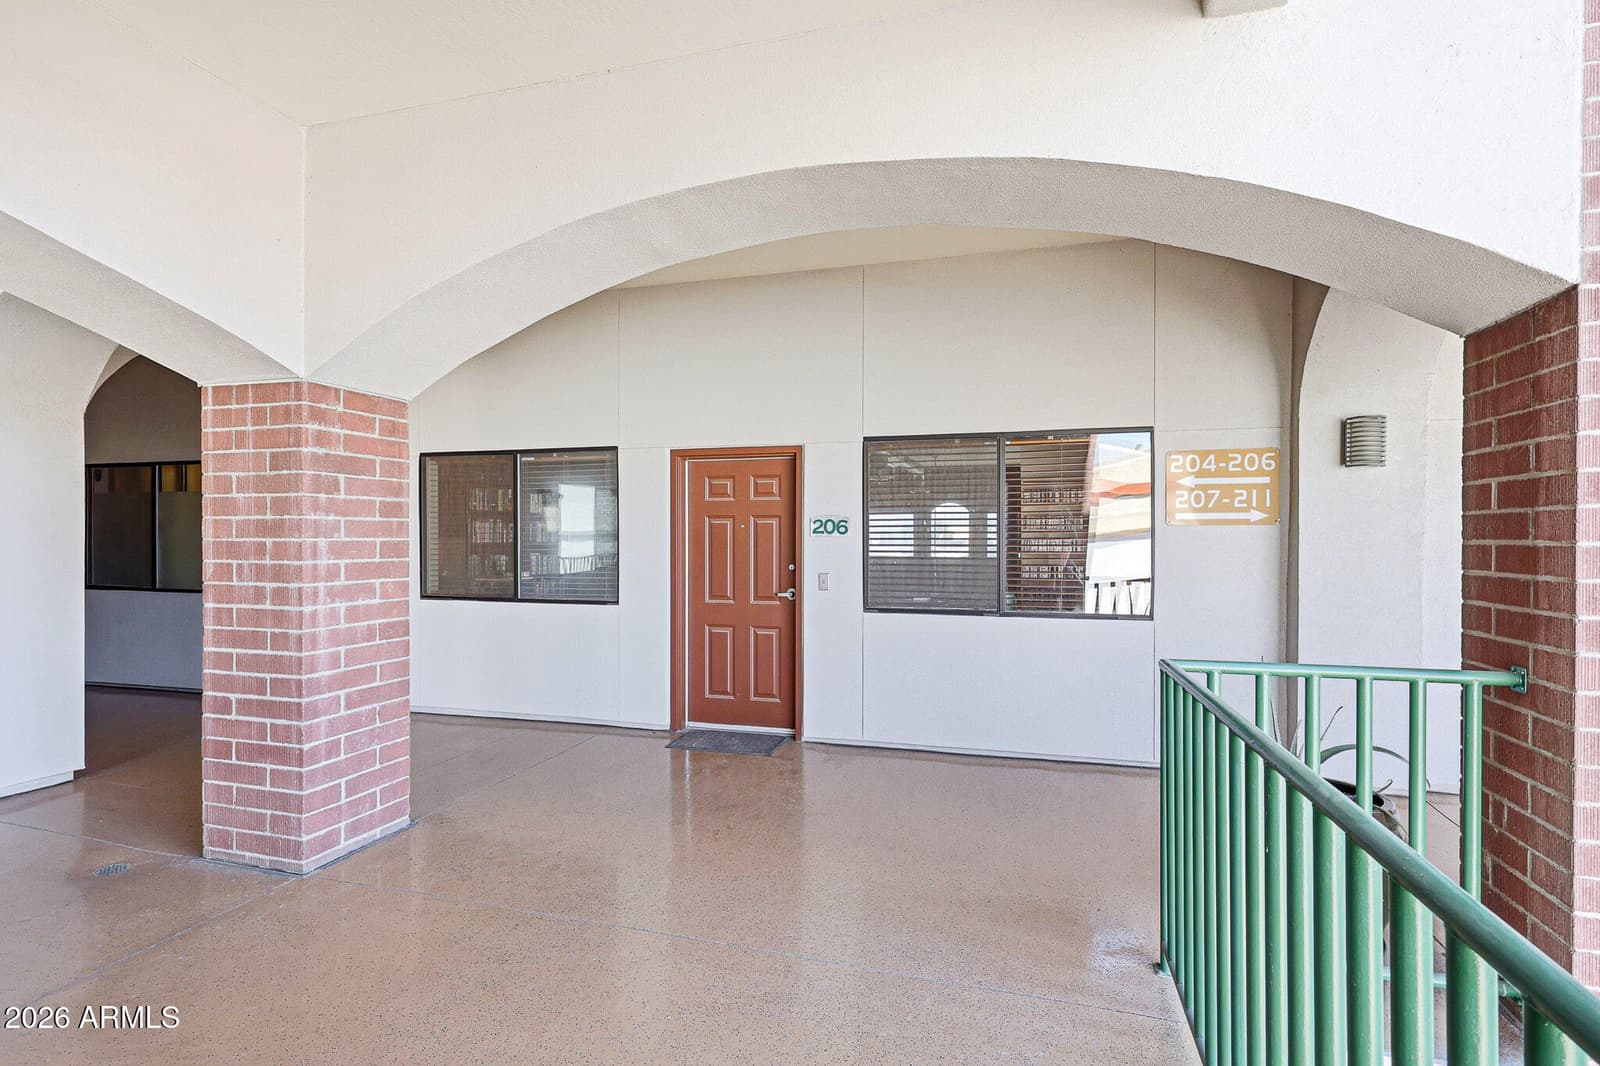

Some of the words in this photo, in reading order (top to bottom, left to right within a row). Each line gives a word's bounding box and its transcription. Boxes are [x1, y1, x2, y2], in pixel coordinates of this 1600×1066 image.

[1170, 452, 1276, 473] 204-206
[1175, 489, 1271, 509] 207-211
[812, 518, 849, 535] 206
